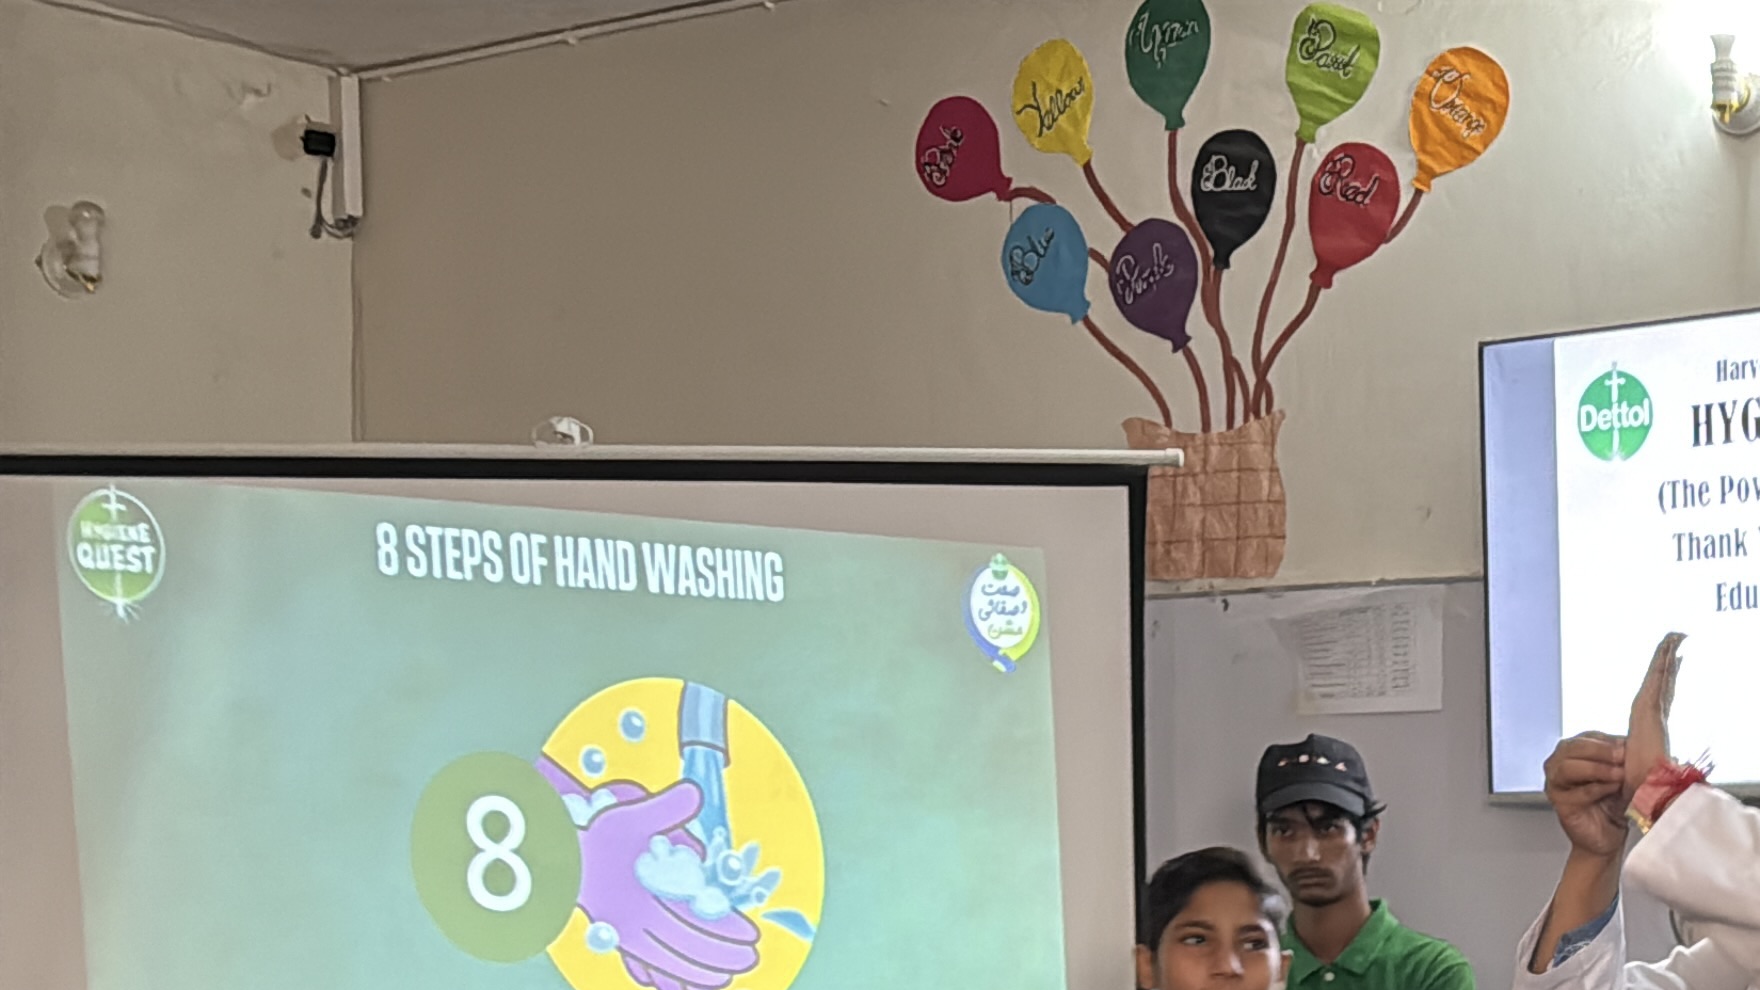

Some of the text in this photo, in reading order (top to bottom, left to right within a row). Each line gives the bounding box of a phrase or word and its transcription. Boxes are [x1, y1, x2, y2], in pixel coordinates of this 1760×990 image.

[1015, 76, 1085, 137] Yellow
[1319, 153, 1379, 206] Red
[1580, 397, 1650, 432] Dettol
[1658, 477, 1711, 515] (The
[76, 542, 156, 575] QUEST
[376, 522, 784, 603] 8 STEPS OF HAND WASHING
[1672, 528, 1748, 562] Thank
[466, 795, 532, 912] 8
